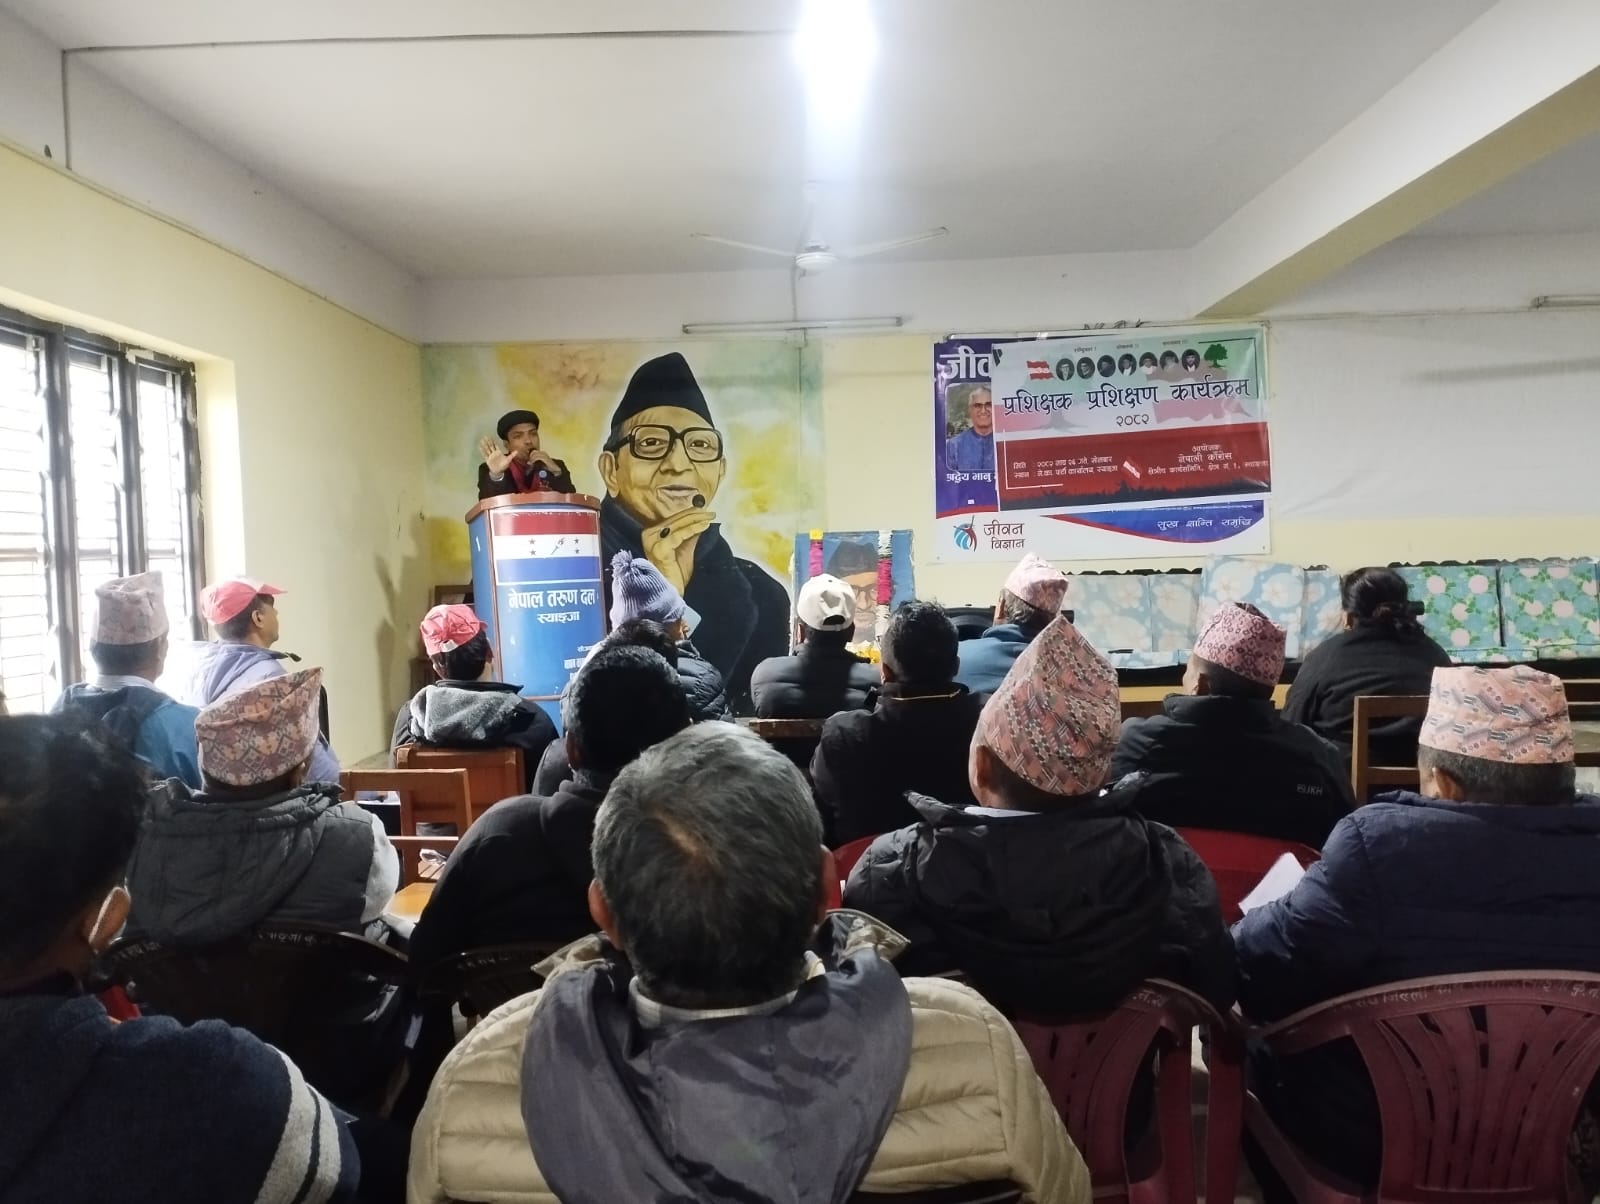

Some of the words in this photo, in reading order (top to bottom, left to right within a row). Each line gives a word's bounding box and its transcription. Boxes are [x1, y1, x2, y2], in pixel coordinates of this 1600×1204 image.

[1001, 388, 1073, 416] प्रशिक्षक
[1085, 382, 1160, 409] प्रशिक्षण
[1169, 374, 1251, 400] कार्यक्रम
[1115, 412, 1150, 427] २०८२
[983, 519, 1025, 535] जीवन
[1156, 520, 1180, 531] सुख
[1185, 517, 1214, 528] शान्ति
[990, 536, 1026, 550] विज्ञान
[507, 587, 545, 609] नेपाल
[546, 588, 578, 608] तरुण
[580, 588, 596, 605] दल
